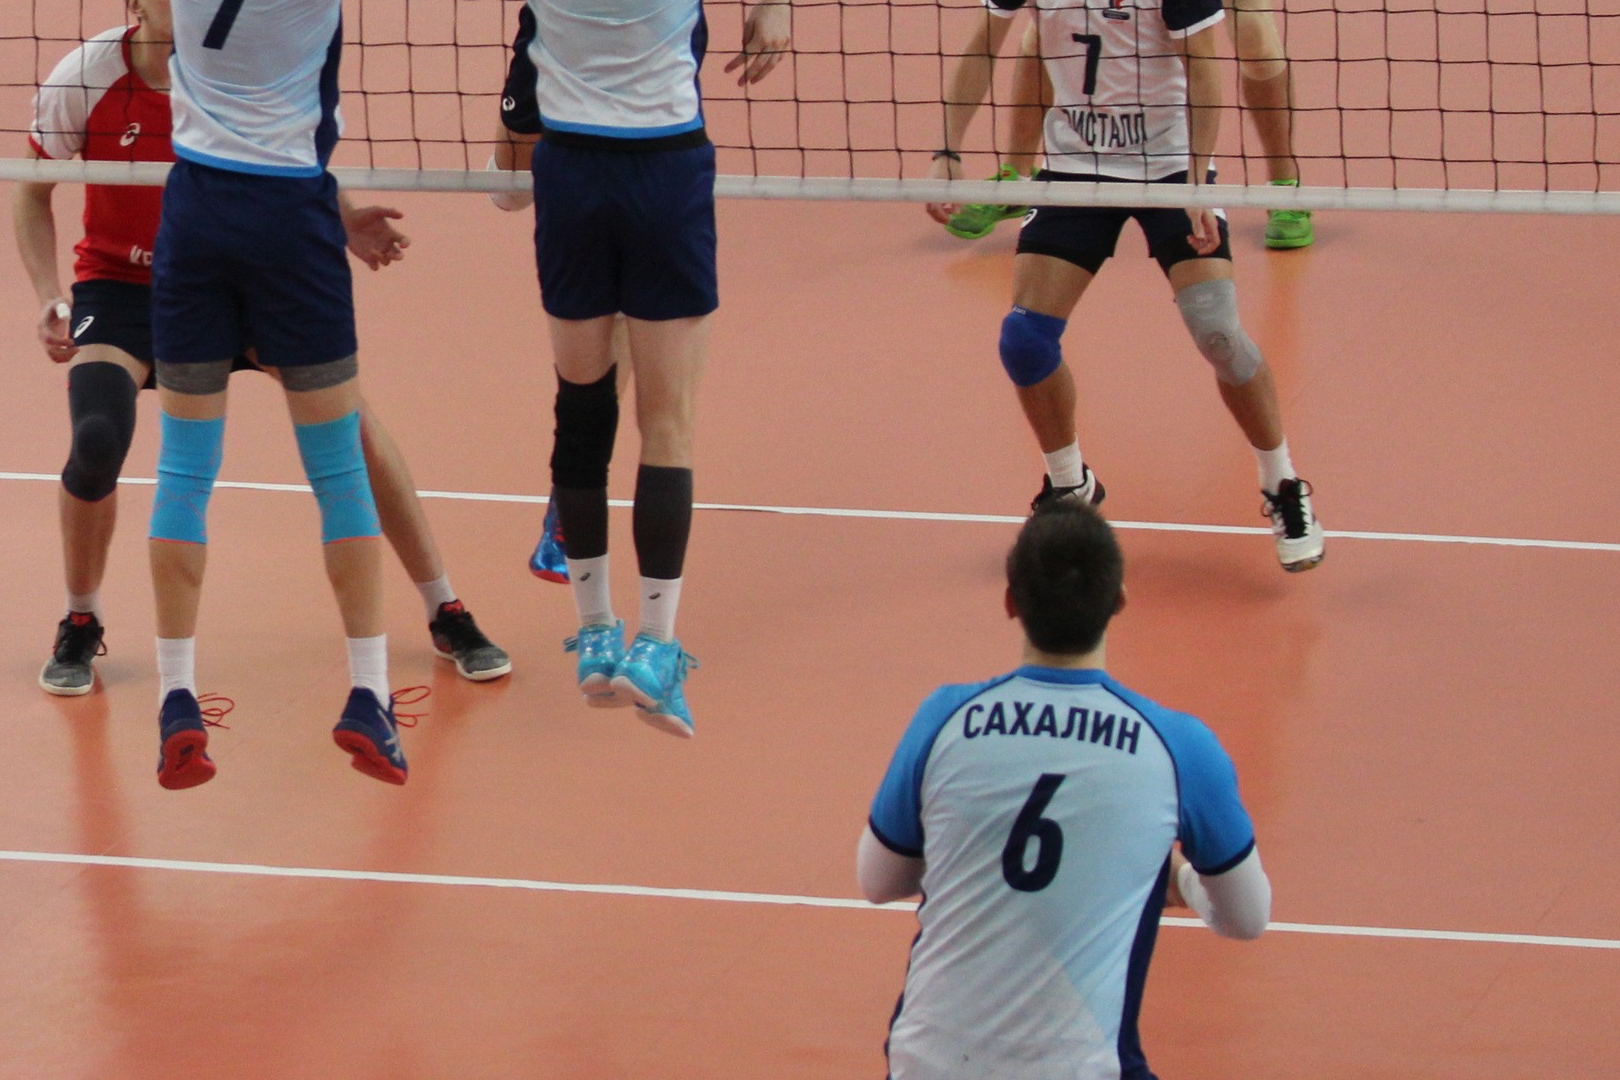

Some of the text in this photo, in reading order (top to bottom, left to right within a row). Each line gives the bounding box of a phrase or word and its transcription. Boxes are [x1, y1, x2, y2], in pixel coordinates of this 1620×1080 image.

[1071, 33, 1102, 95] 7
[963, 701, 1141, 755] САХАЛИН
[1002, 772, 1067, 892] 6
